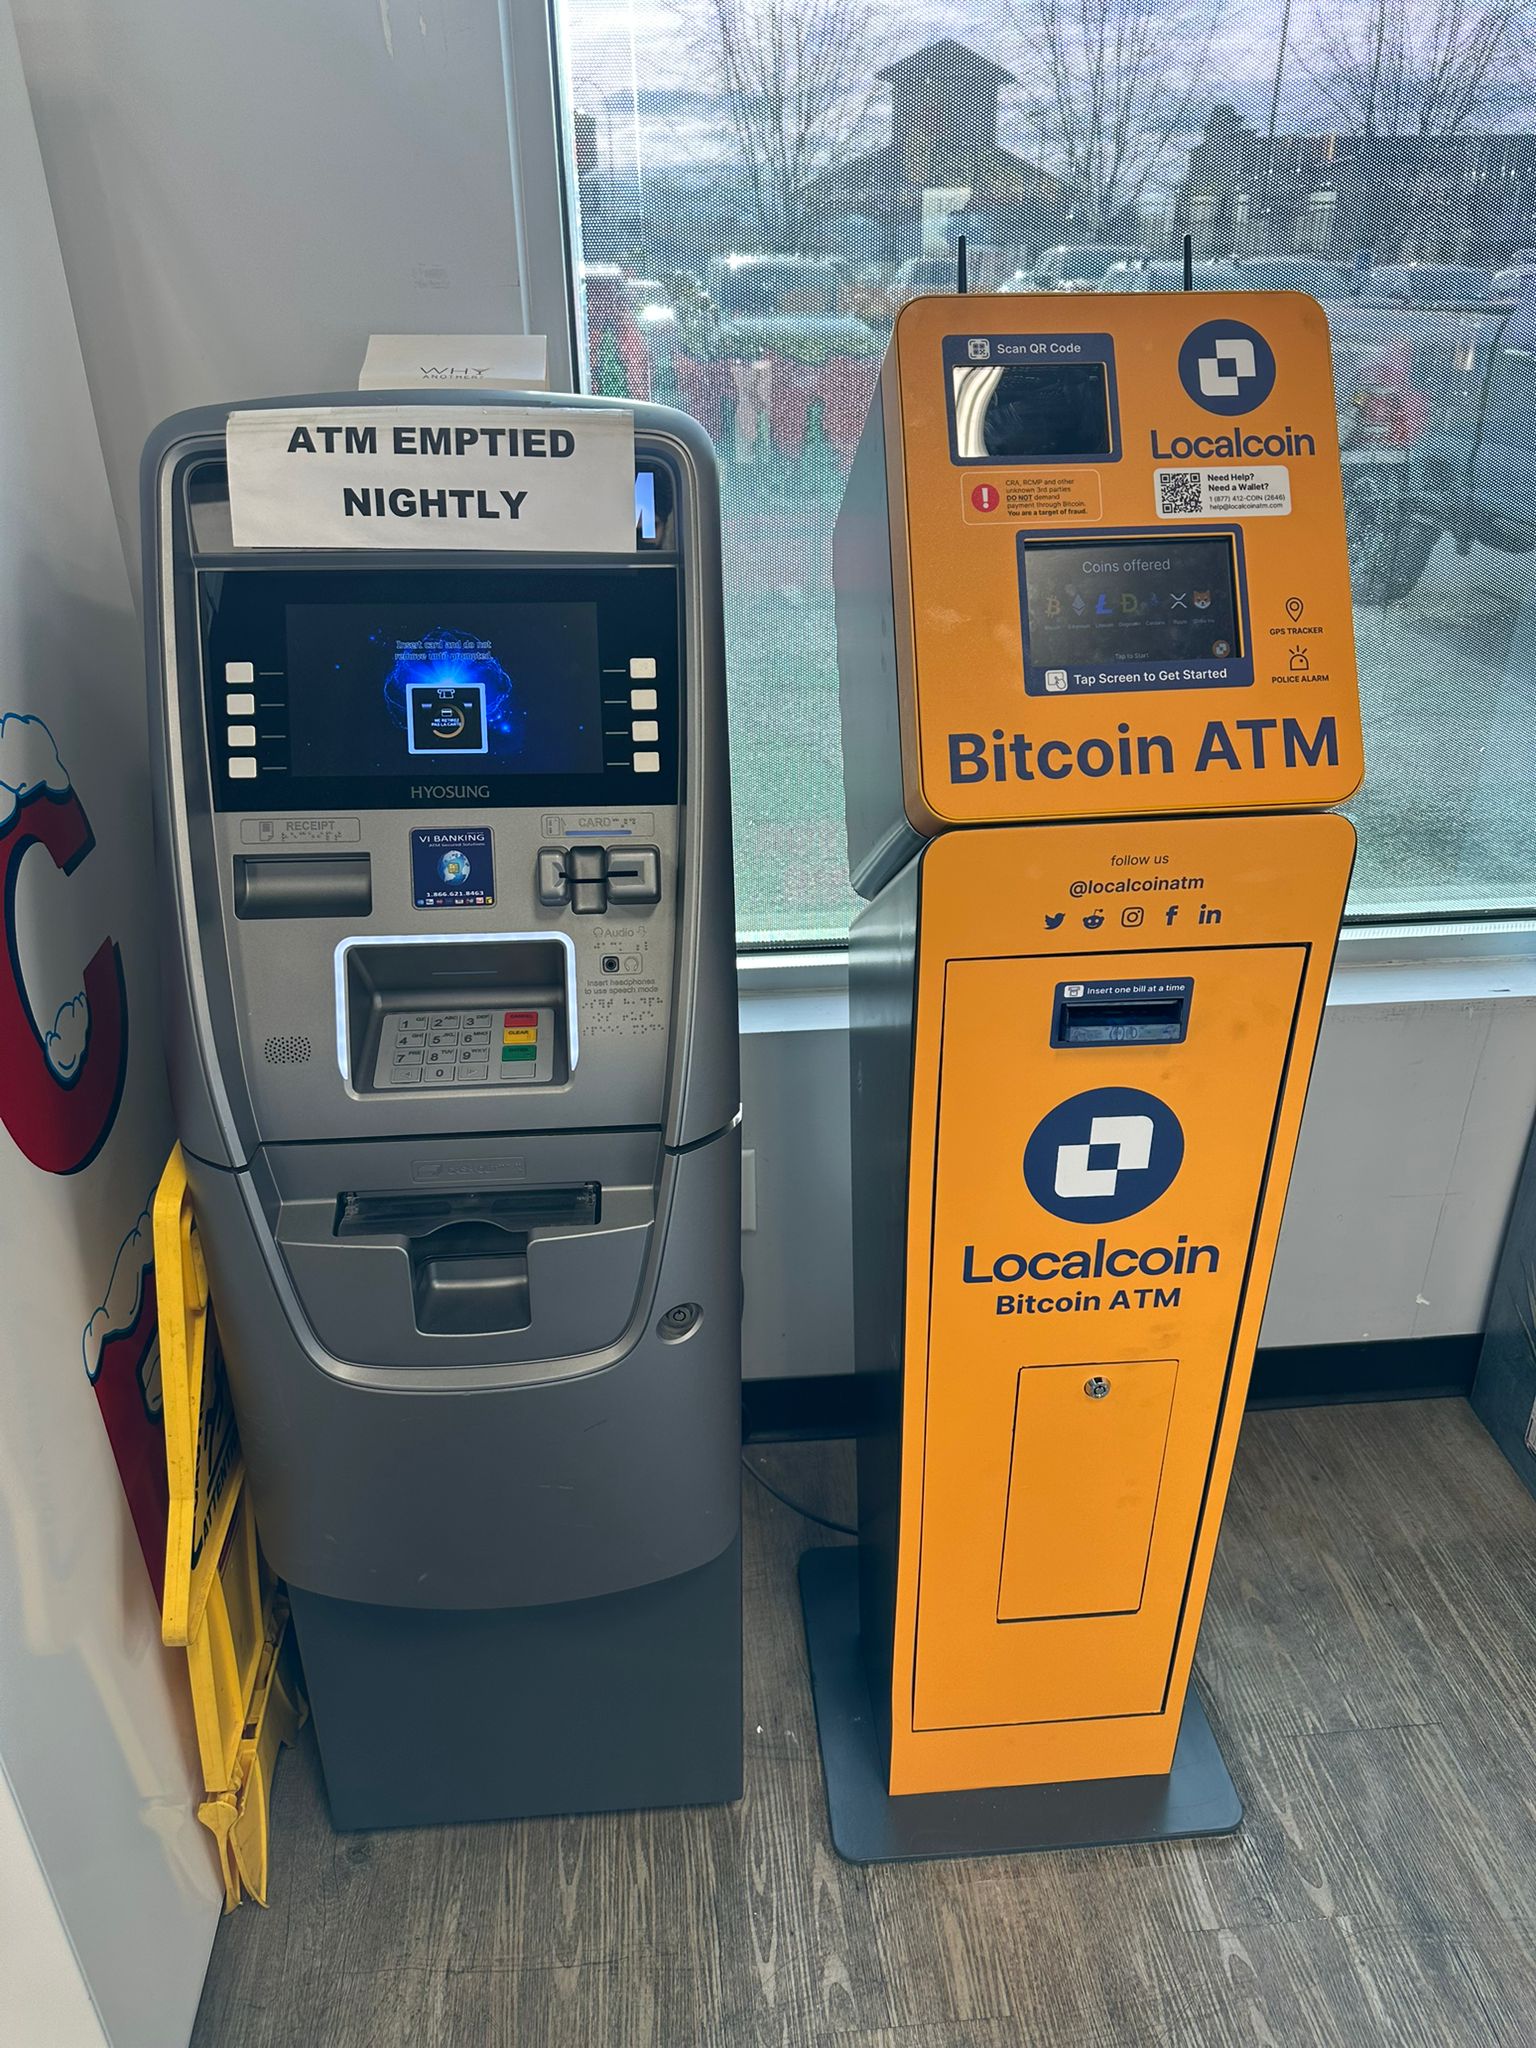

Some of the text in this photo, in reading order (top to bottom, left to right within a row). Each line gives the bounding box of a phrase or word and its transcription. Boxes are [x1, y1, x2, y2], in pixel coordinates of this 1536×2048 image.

[997, 342, 1081, 355] Scan QR Code
[420, 367, 490, 375] WHY
[287, 426, 575, 458] ATM EMPTIED
[1150, 426, 1316, 459] Localcoin
[1231, 473, 1255, 482] Help?
[1238, 483, 1269, 491] Wallet?
[343, 488, 528, 519] NIGHTLY
[1036, 501, 1061, 509] through
[1209, 503, 1283, 511] help@localcoinatm.com
[1039, 509, 1059, 517] target
[1082, 557, 1171, 574] Coins offered
[1269, 627, 1324, 636] GPS TRACKER
[1074, 667, 1228, 688] Tap Screen to Get Started
[1272, 675, 1329, 684] POLICE ALARM
[947, 717, 1340, 784] Bitcoin ATM
[411, 786, 490, 799] HYOSUNG
[286, 821, 336, 831] RECEIPT
[578, 817, 611, 828] CARD
[419, 834, 485, 843] VI BANKING
[1110, 854, 1170, 867] follow us
[1069, 875, 1205, 898] @localcoinatm
[605, 927, 635, 937] Audio
[610, 979, 656, 987] headphones
[584, 987, 592, 995] to
[609, 986, 636, 995] speech
[637, 985, 659, 993] mode
[1087, 986, 1112, 995] Insert
[1114, 986, 1130, 994] one
[1133, 984, 1146, 993] bill
[1147, 985, 1156, 993] at
[1166, 983, 1186, 992] time
[402, 1020, 409, 1028] 1
[434, 1019, 443, 1027] 2
[466, 1017, 475, 1026] 3
[398, 1037, 407, 1045] 4
[432, 1035, 441, 1044] 5
[464, 1034, 473, 1043] 6
[397, 1054, 406, 1063] 7
[430, 1053, 439, 1061] 8
[463, 1051, 472, 1060] 9
[436, 1069, 444, 1077] 0
[962, 1235, 1220, 1283] Localcoin
[995, 1287, 1182, 1315] Bitcoin ATM
